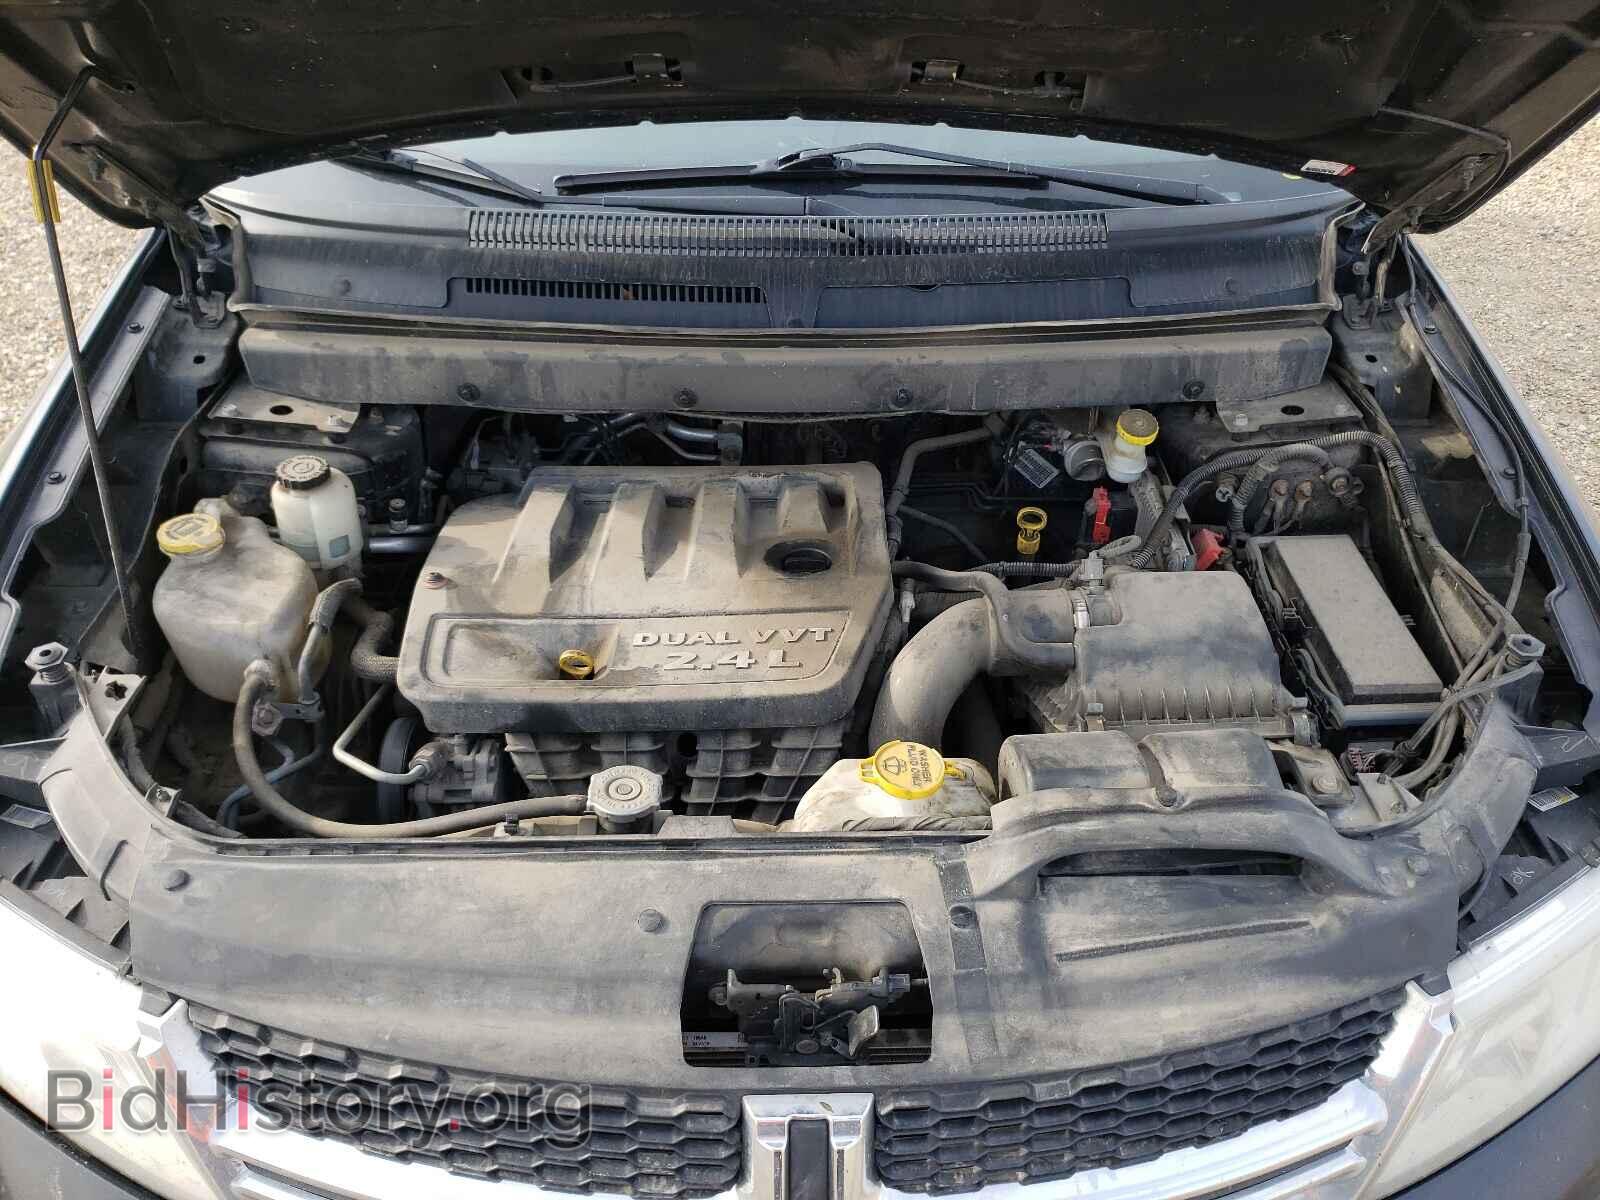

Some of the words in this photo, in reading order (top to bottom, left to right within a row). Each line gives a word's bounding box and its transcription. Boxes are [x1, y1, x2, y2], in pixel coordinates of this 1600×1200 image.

[633, 631, 740, 647] DUAL
[756, 627, 833, 644] VVT
[919, 749, 932, 784] WASHER
